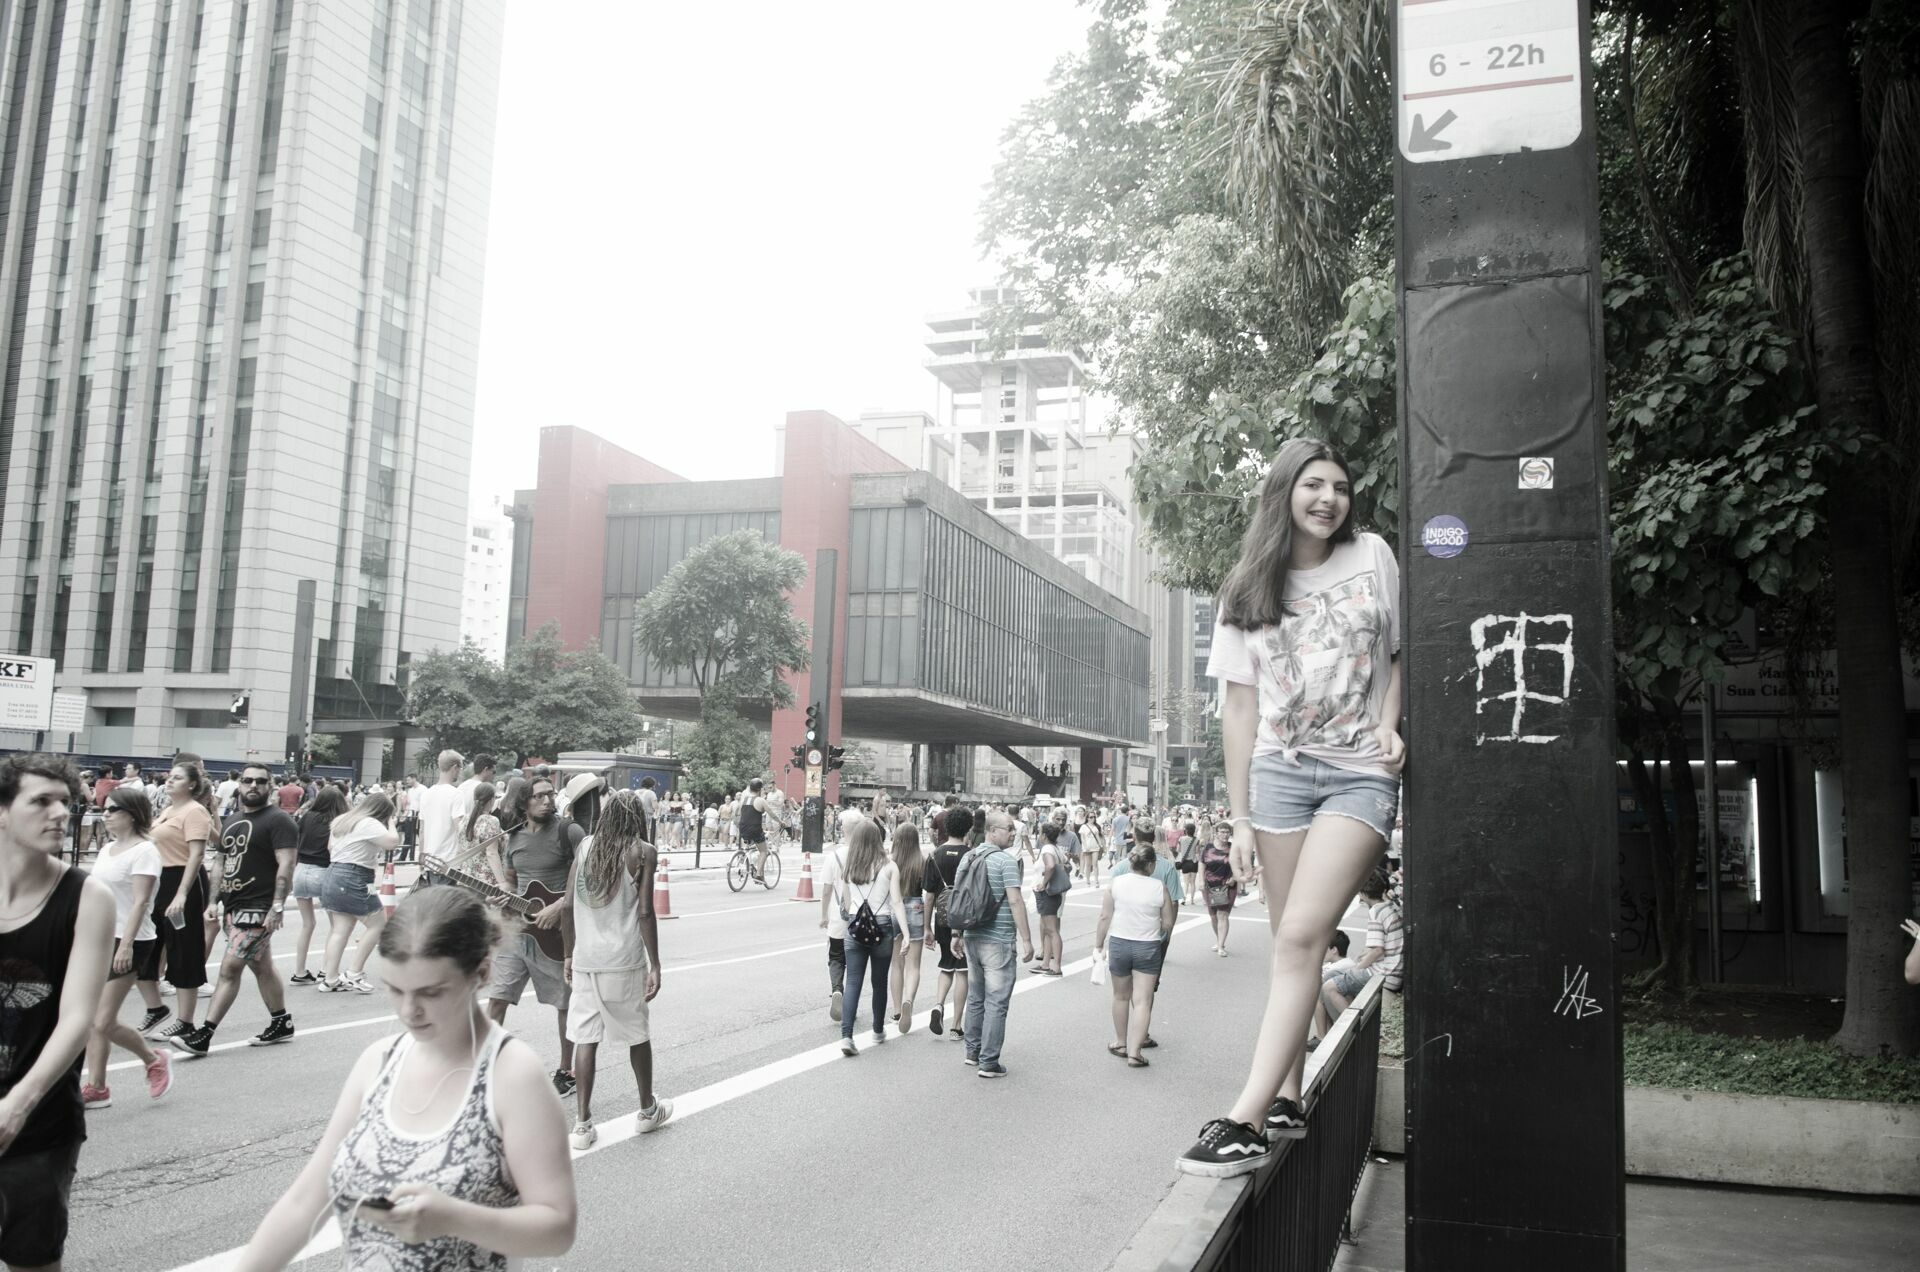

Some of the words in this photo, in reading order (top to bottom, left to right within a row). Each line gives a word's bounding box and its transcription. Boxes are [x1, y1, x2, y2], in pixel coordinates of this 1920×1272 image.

[1429, 53, 1447, 77] 6
[1487, 43, 1545, 71] 22h
[1425, 527, 1468, 539] INDIGO
[1425, 535, 1464, 546] MOOD
[1726, 685, 1756, 697] Sua
[232, 910, 265, 924] VAN
